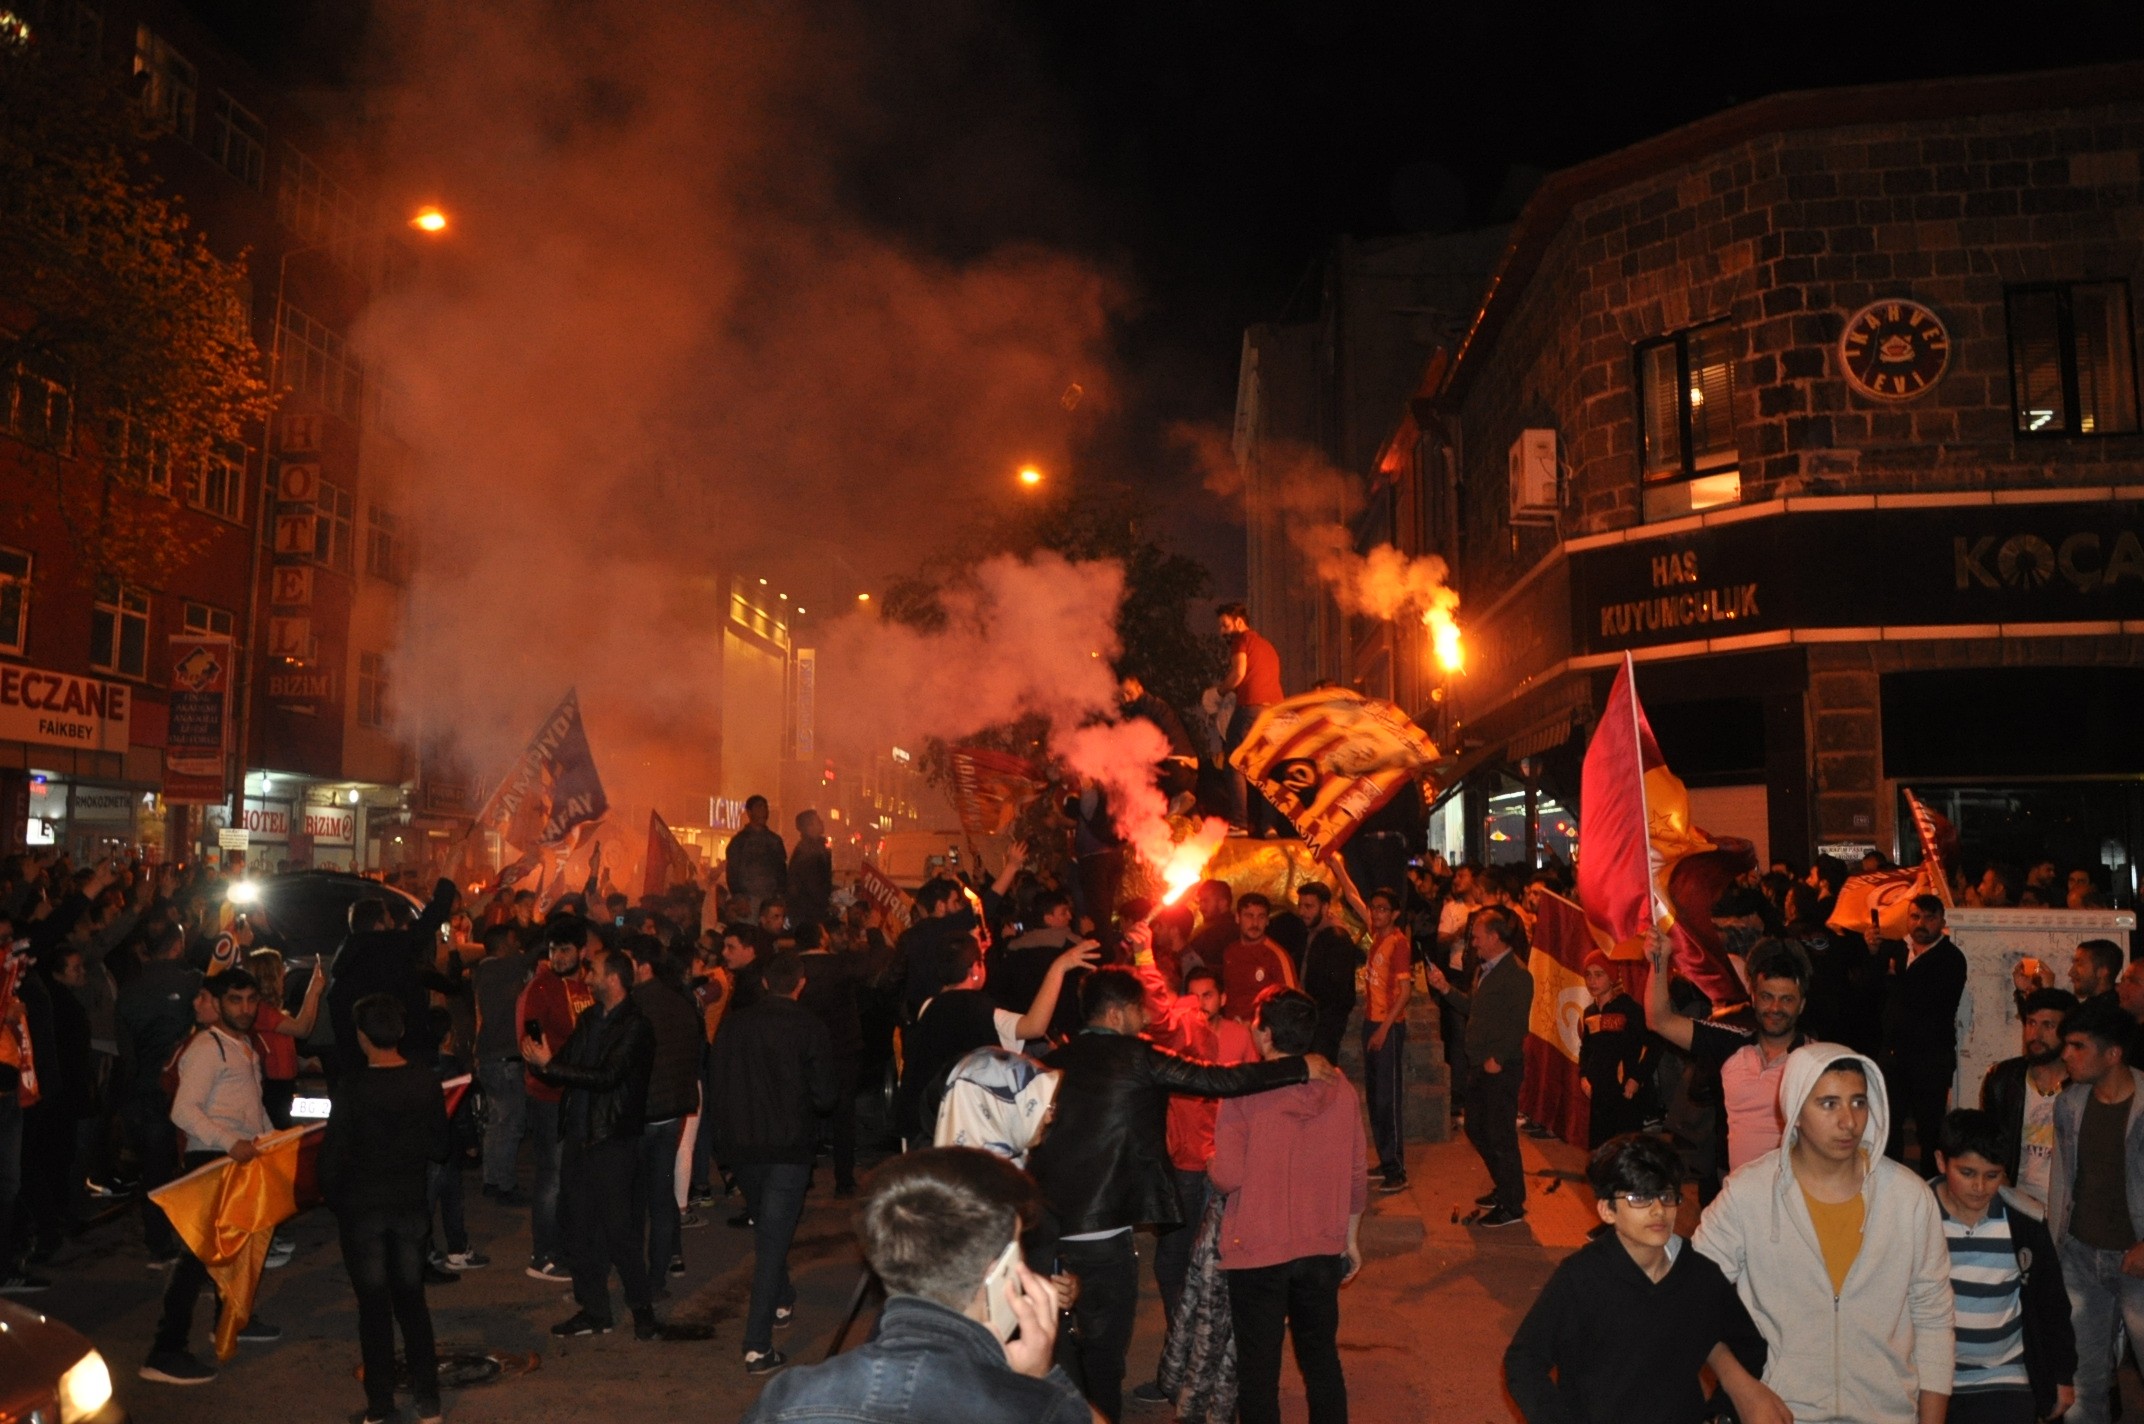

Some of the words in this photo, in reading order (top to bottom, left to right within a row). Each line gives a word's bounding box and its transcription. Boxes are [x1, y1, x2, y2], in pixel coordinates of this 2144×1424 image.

[276, 416, 314, 656] HOTEL
[1953, 529, 2144, 594] KOÇA
[1652, 550, 1698, 588] HAS
[1601, 582, 1760, 638] KUYUMCULUK
[1, 667, 124, 721] ECZANE
[39, 716, 93, 740] FAİKBEY
[243, 808, 287, 833] HOTEL
